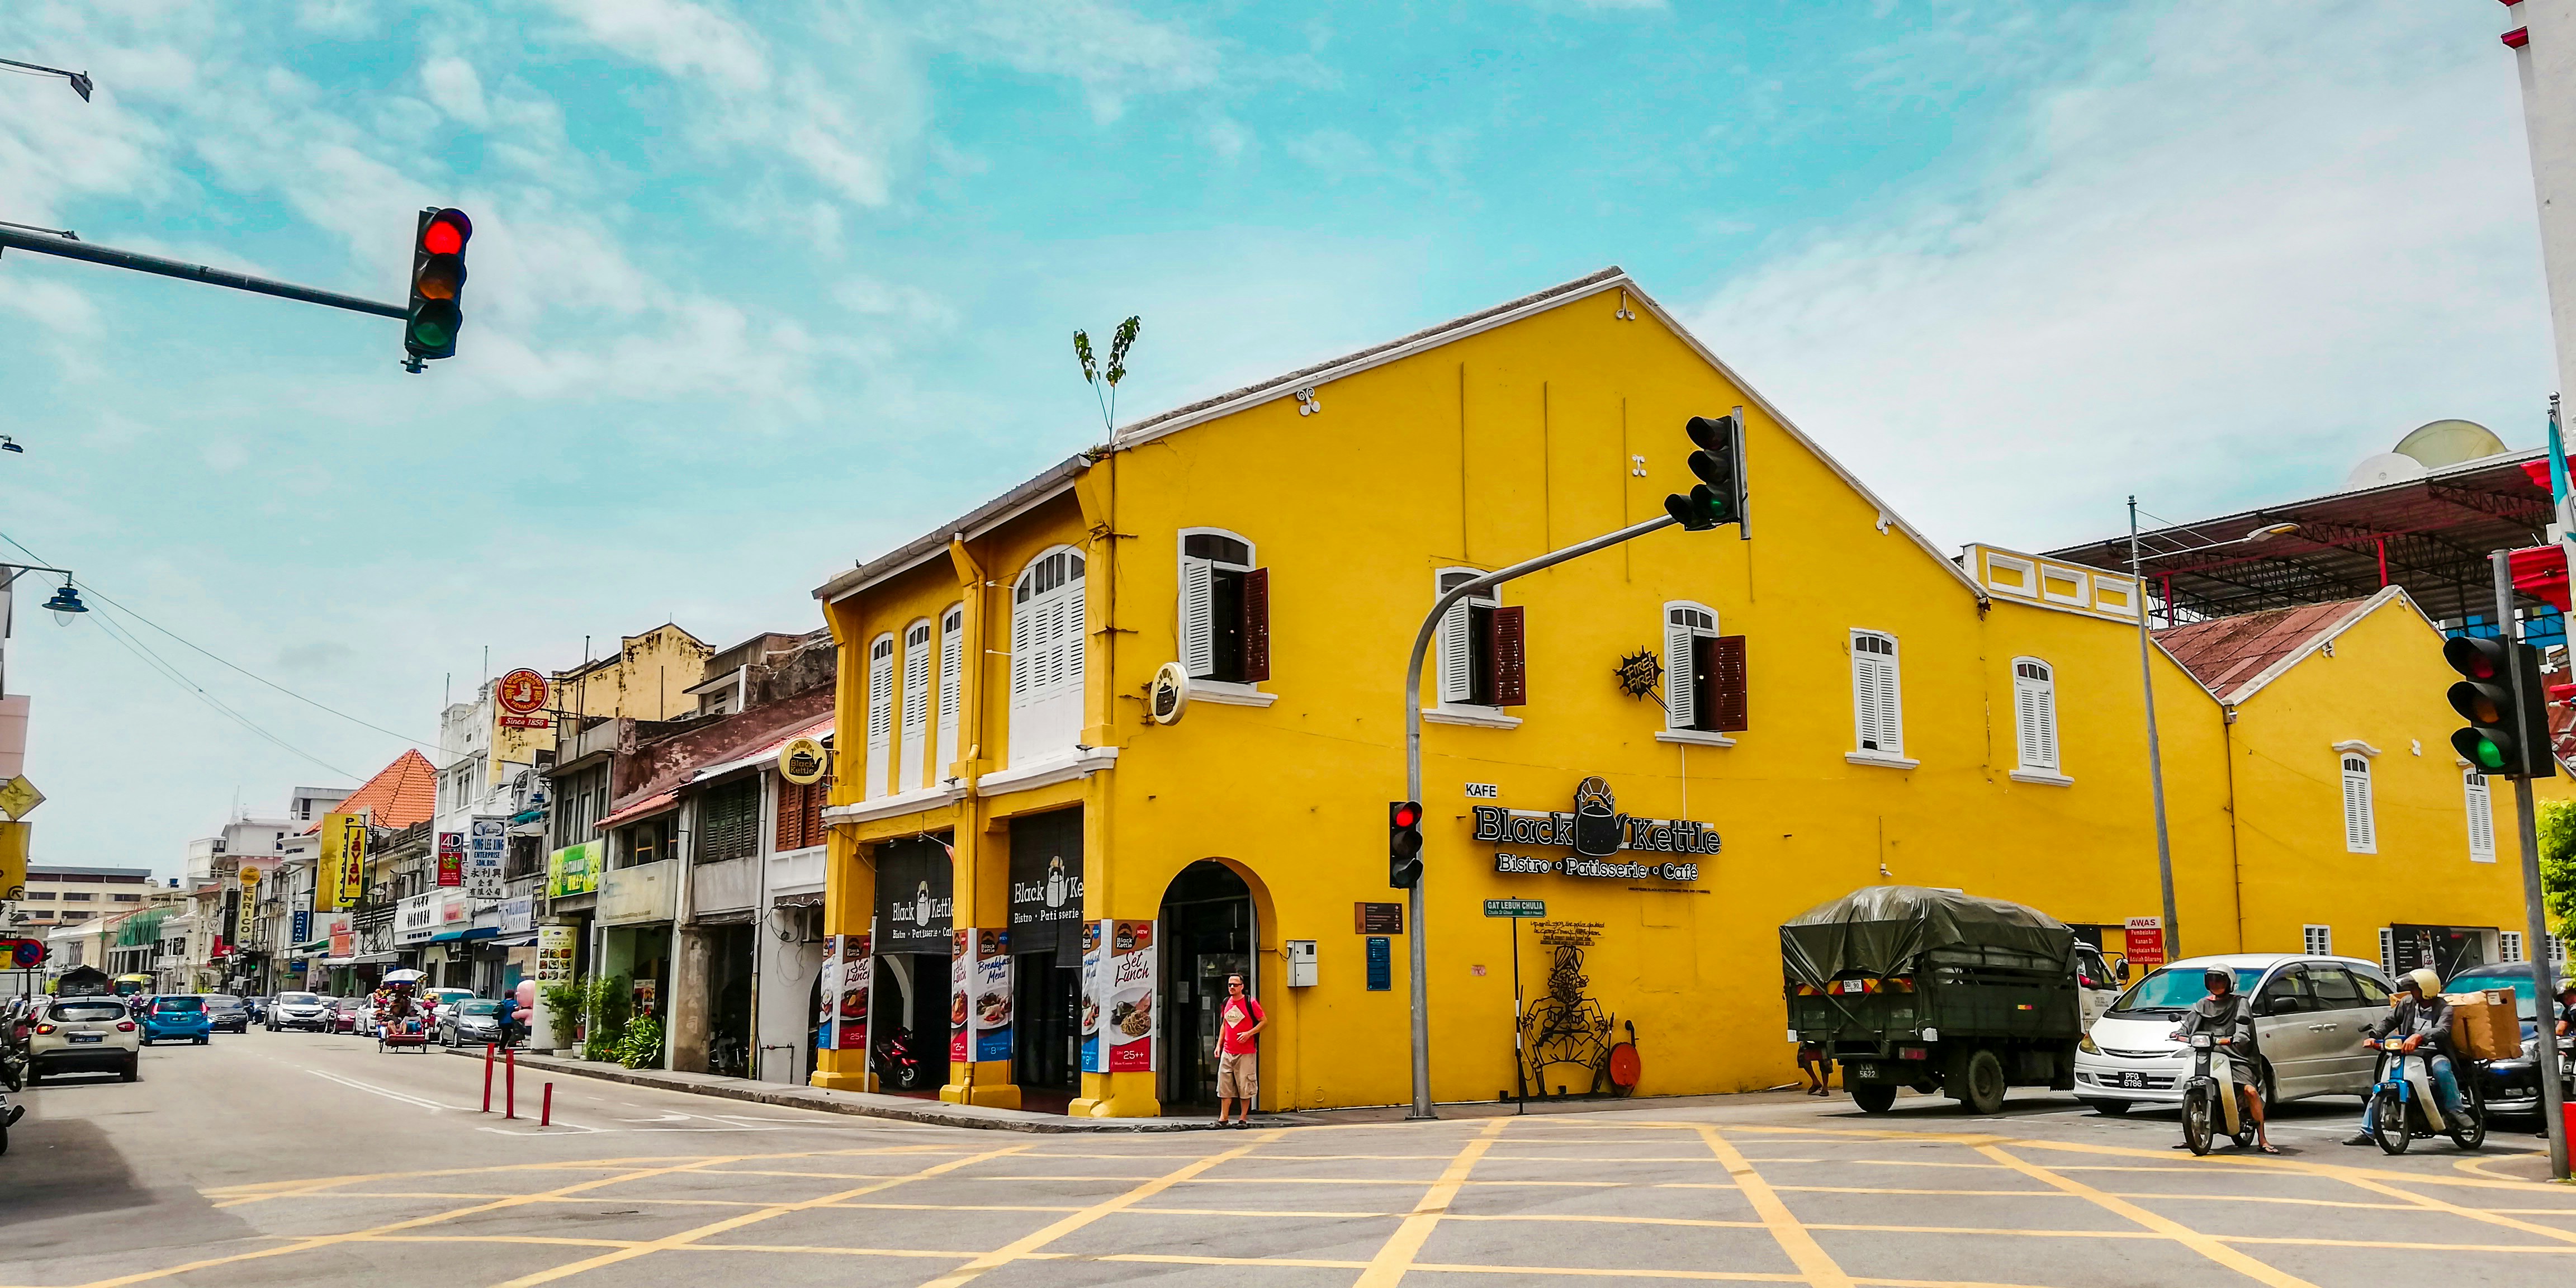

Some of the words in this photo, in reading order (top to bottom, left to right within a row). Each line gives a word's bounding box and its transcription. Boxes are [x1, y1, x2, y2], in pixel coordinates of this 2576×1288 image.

[525, 673, 542, 685] HIANG
[511, 700, 536, 709] PENANG
[1466, 784, 1497, 797] KAFE
[1473, 806, 1574, 846] Black
[1630, 818, 1722, 855] Kettle
[472, 839, 484, 850] YONG
[493, 839, 504, 851] XING
[1499, 853, 1551, 874] Bistro
[1566, 857, 1649, 879] Patisserie
[1663, 862, 1699, 881] Café
[1014, 880, 1045, 904] Black
[240, 887, 254, 933] ENRICO
[892, 901, 915, 921] Black
[1488, 901, 1500, 910] GAT
[1500, 901, 1521, 910] LEBUH
[1014, 912, 1033, 924] Bistro
[1040, 907, 1079, 921] Patisserie
[295, 911, 304, 941] PARKING
[892, 929, 906, 939] Bistro
[850, 958, 869, 974] Set
[1122, 951, 1143, 970] Set
[986, 969, 1006, 984] Menu
[1115, 960, 1149, 987] Lunch
